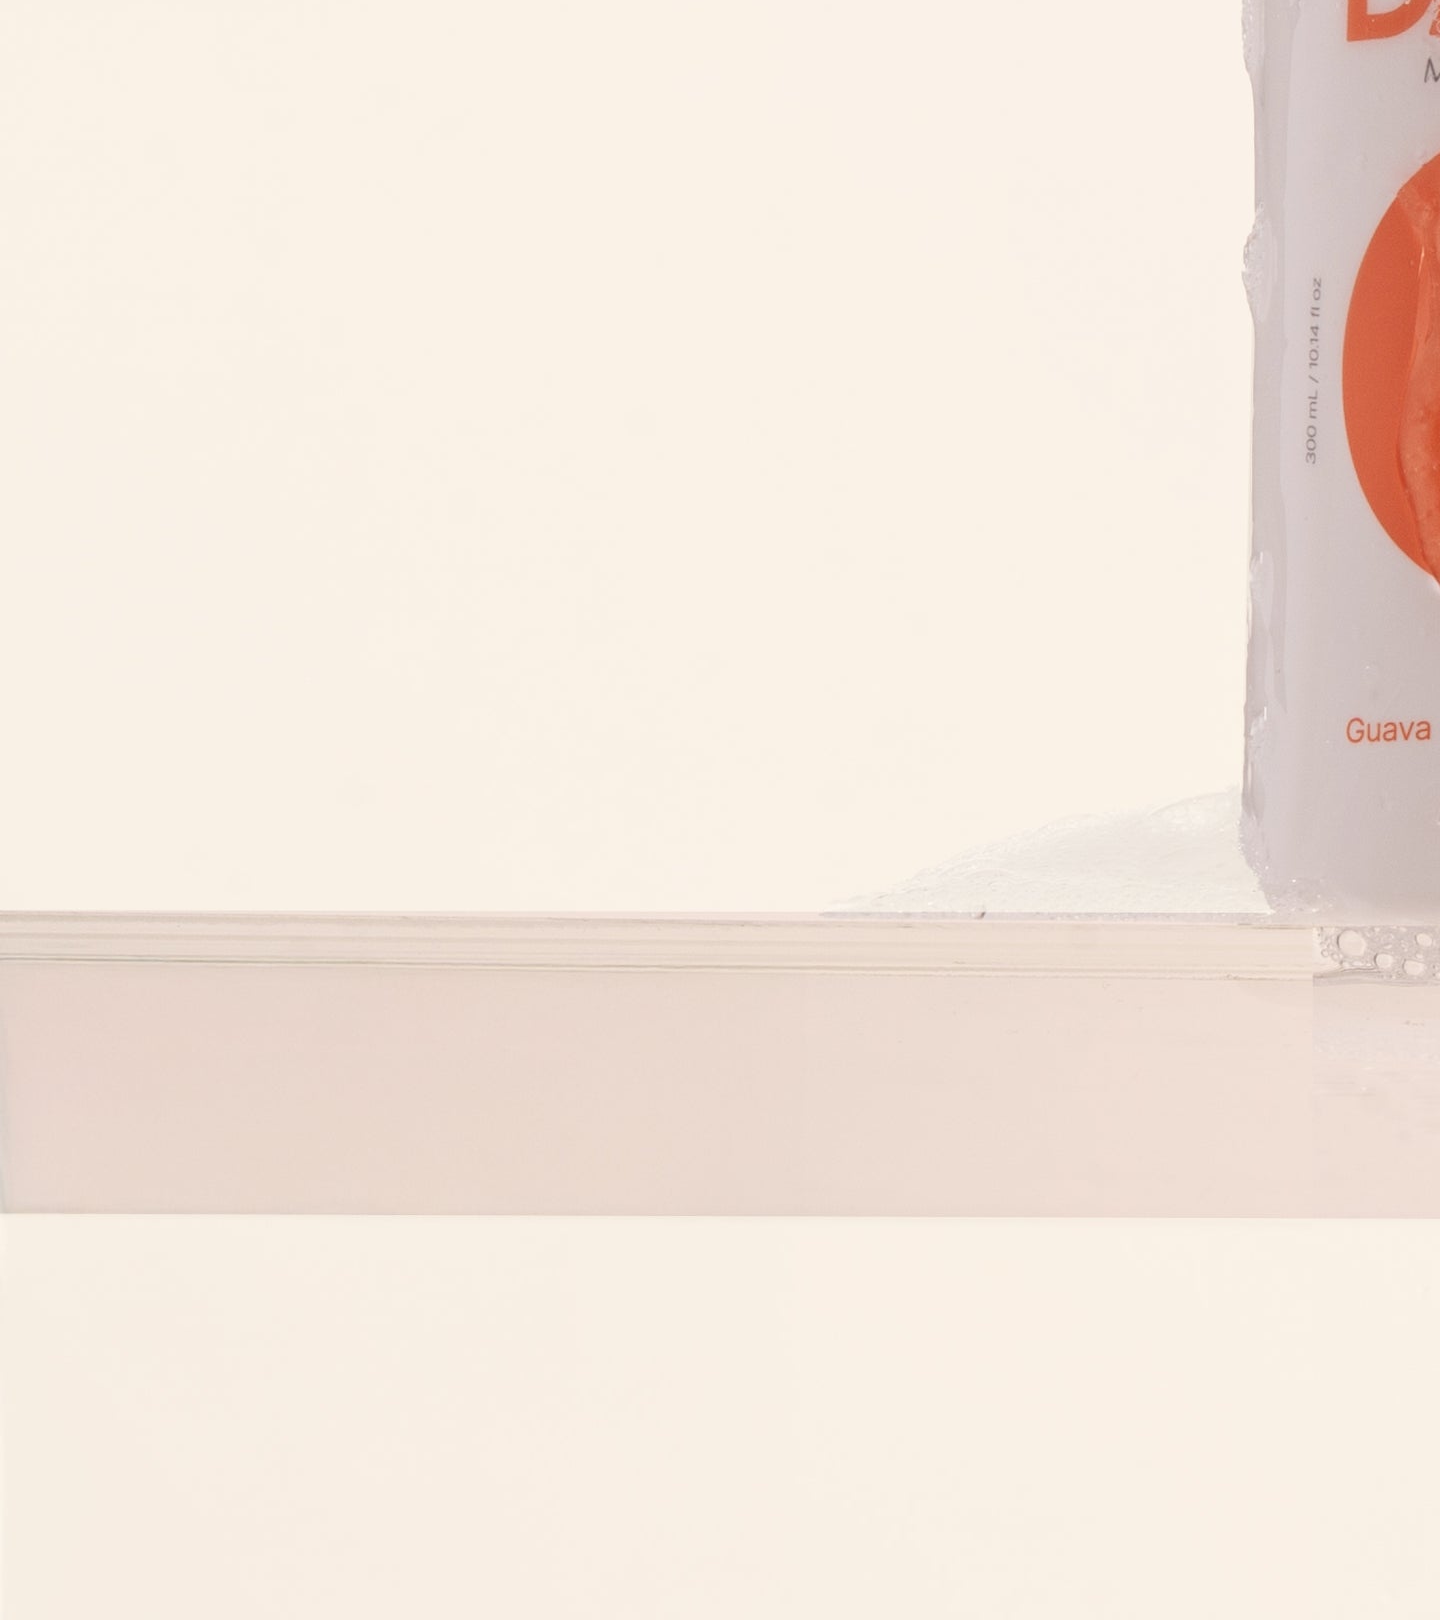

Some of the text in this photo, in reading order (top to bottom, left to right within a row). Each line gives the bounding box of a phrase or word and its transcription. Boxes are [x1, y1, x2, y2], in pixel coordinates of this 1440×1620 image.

[1305, 425, 1317, 465] 300
[1312, 277, 1321, 301] oz
[1345, 717, 1432, 744] Guava
